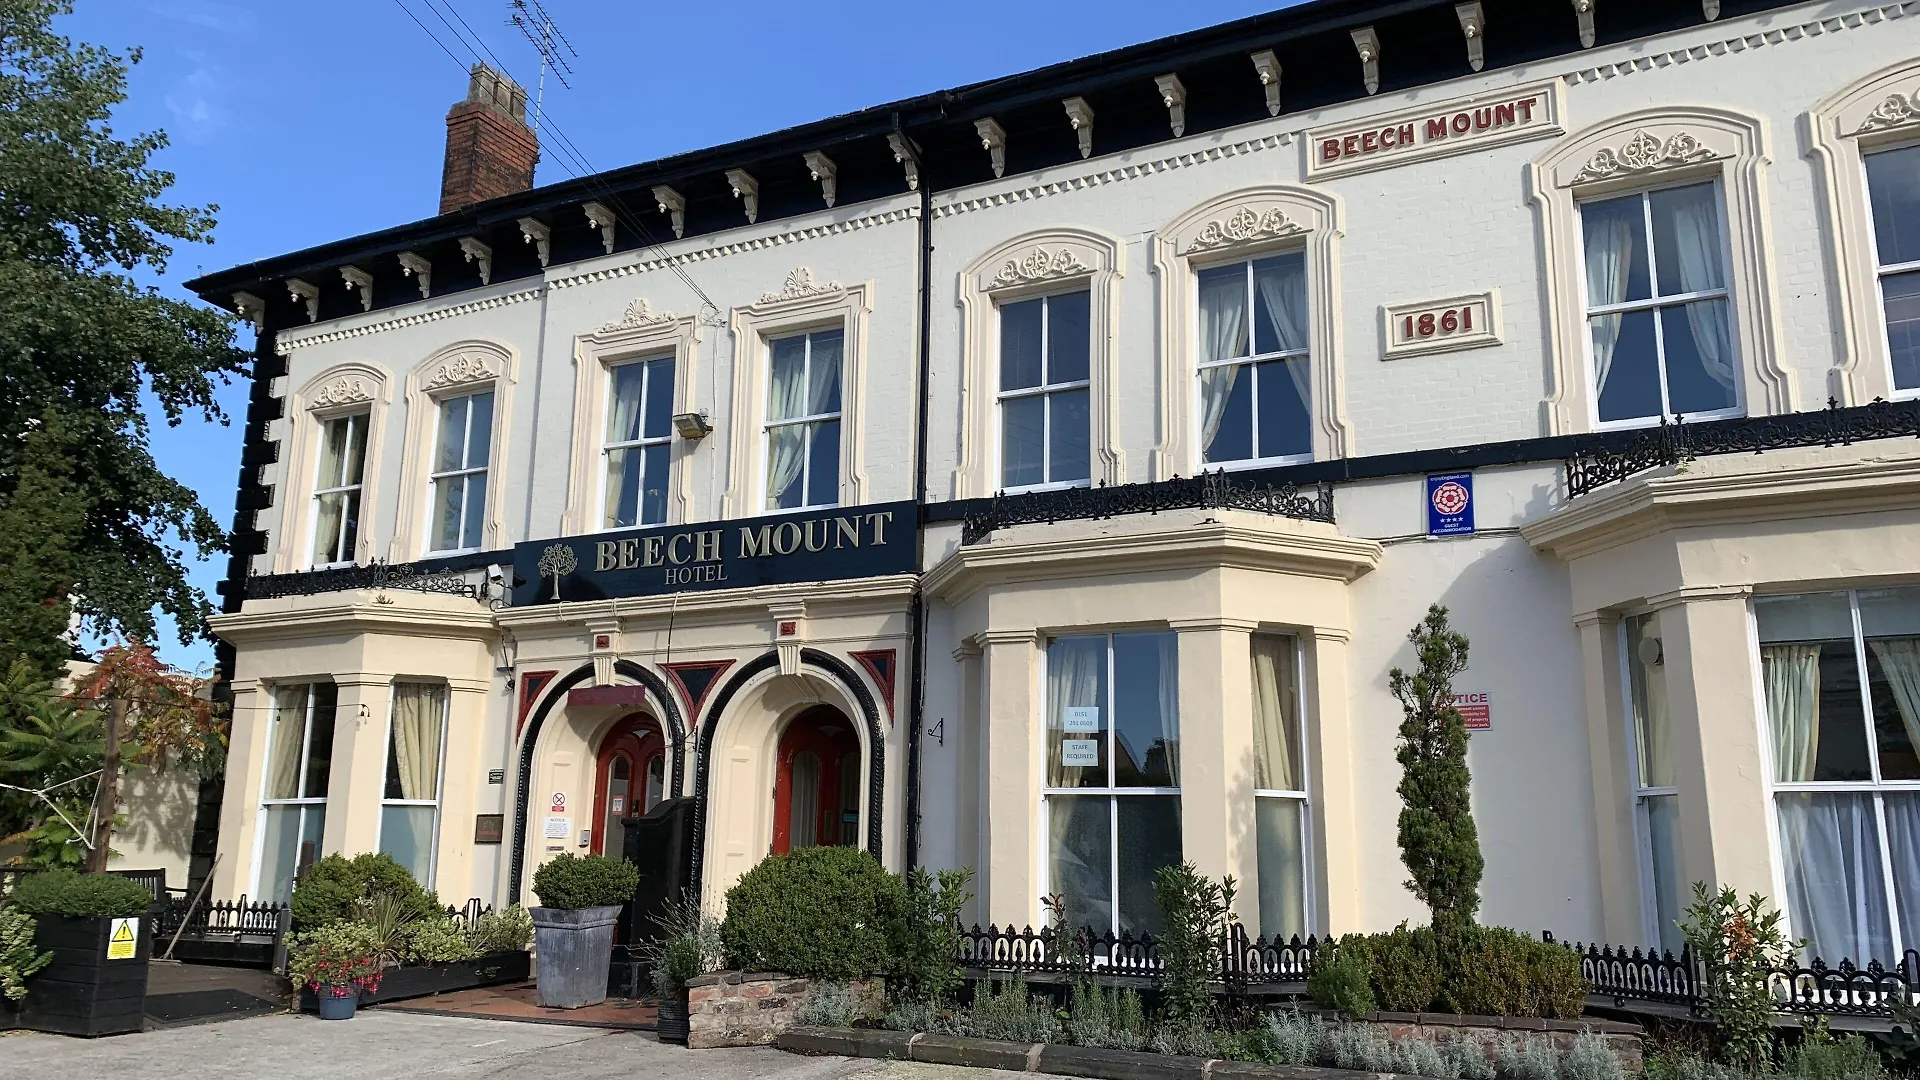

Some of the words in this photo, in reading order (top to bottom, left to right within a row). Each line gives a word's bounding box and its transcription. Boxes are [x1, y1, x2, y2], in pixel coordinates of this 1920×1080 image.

[1322, 123, 1415, 160] BEECH
[1427, 97, 1537, 139] MOUNT
[1405, 306, 1472, 338] 1861
[593, 529, 724, 572] BEECH
[736, 511, 893, 559] MOUNT
[664, 564, 728, 585] HOTEL
[1450, 693, 1488, 703] TICE
